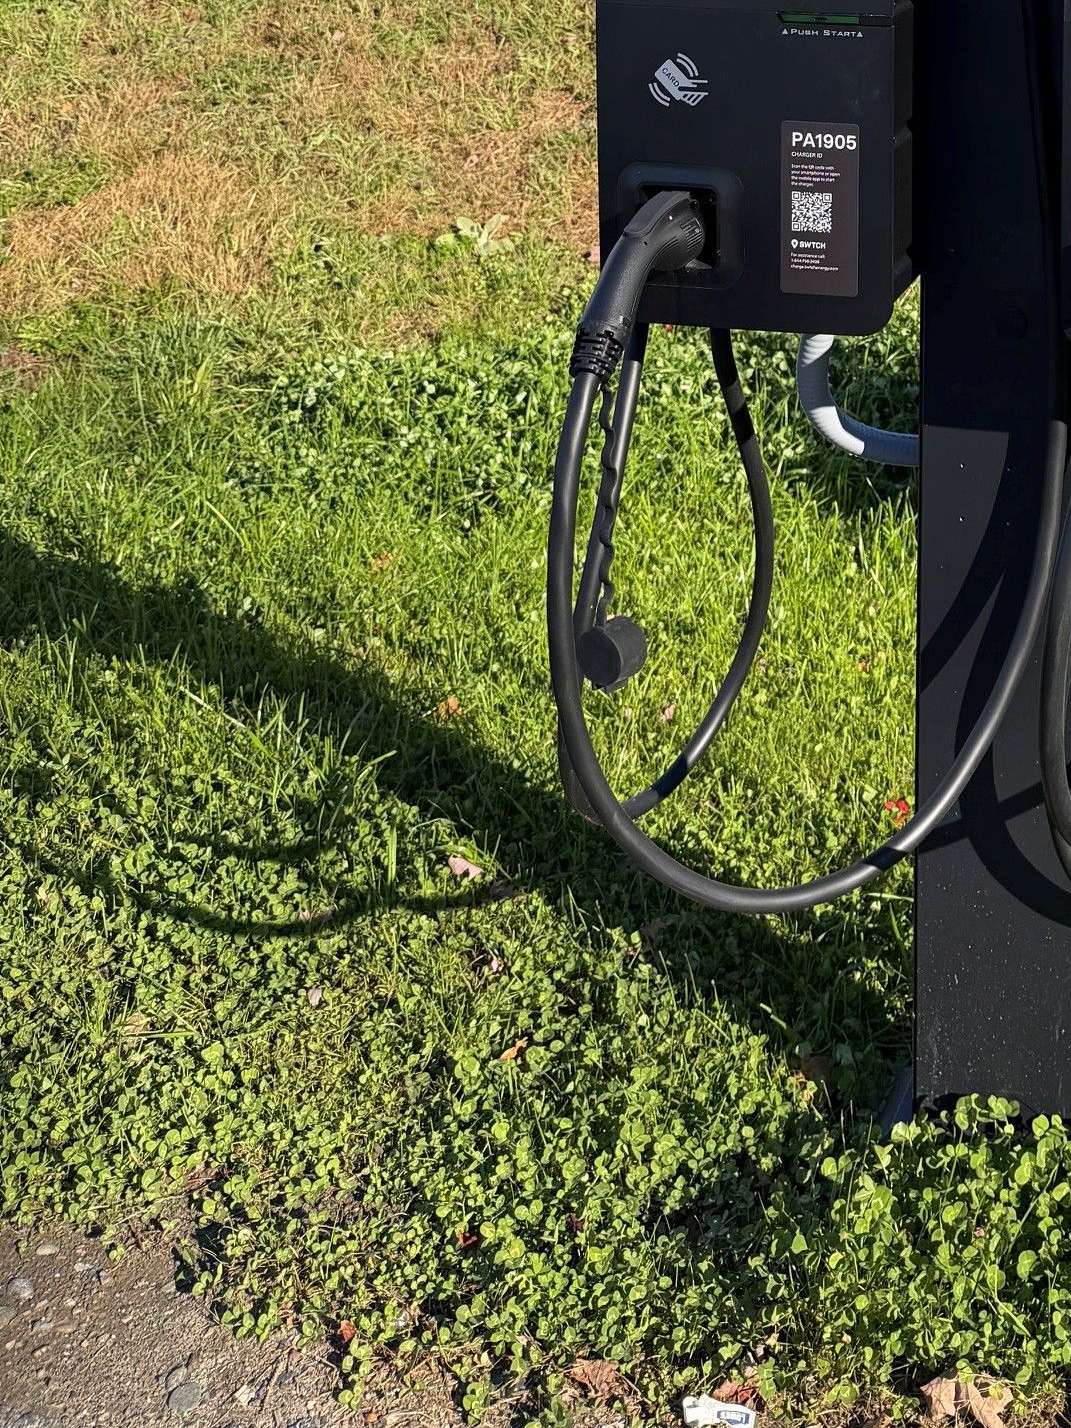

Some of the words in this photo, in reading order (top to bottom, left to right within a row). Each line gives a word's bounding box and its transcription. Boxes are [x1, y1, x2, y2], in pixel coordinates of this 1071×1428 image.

[661, 67, 680, 87] CARD
[791, 131, 857, 150] PA1905
[799, 240, 826, 249] SWTCH
